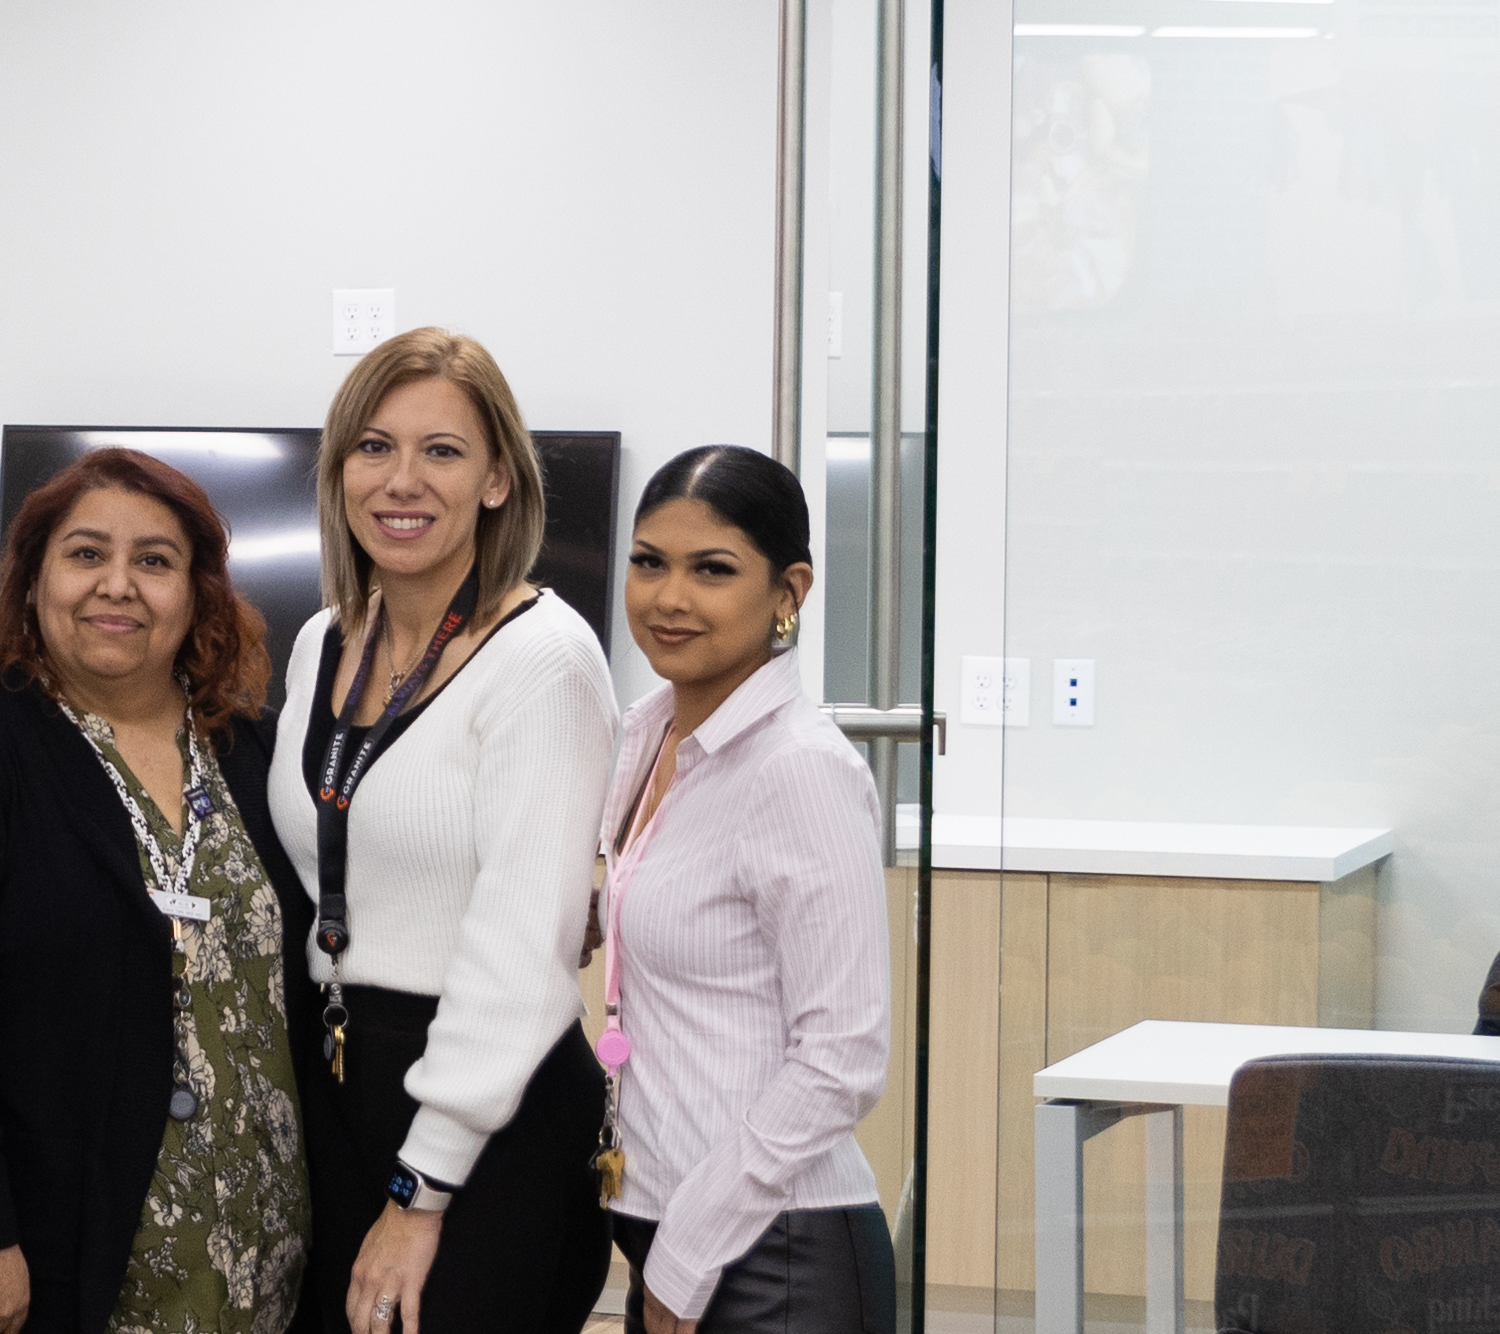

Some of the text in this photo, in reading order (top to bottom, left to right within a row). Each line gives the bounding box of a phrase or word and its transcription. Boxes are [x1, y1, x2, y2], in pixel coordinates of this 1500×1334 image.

[426, 611, 463, 659] THERE
[324, 732, 344, 785] GRANITE
[342, 741, 372, 794] GRANITE
